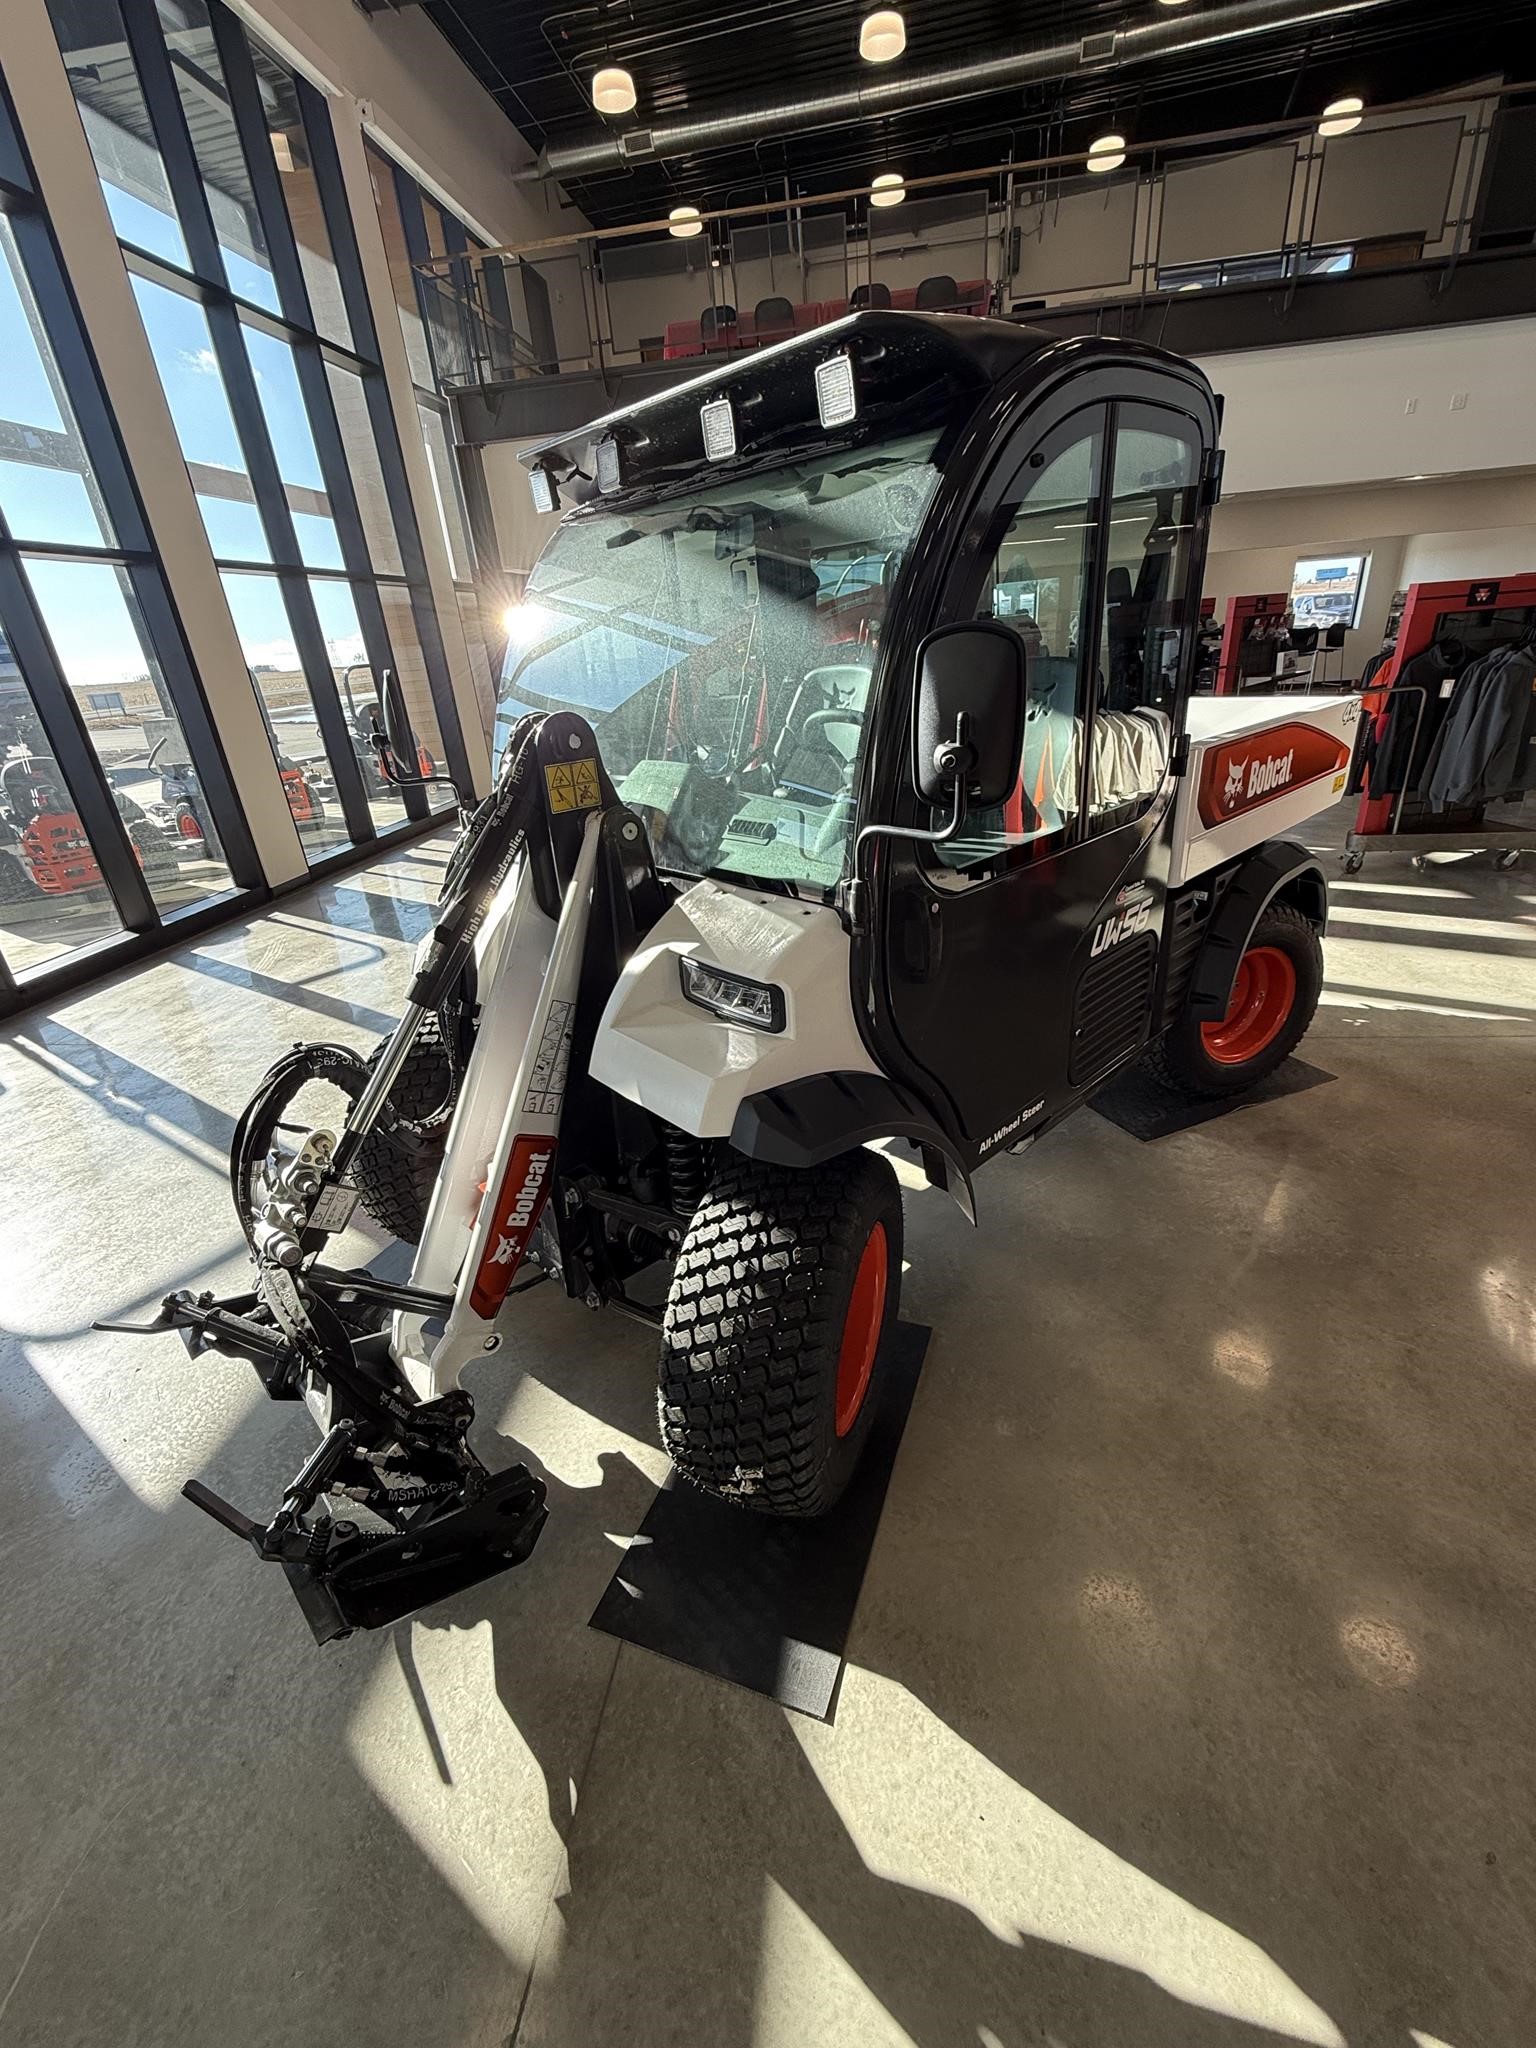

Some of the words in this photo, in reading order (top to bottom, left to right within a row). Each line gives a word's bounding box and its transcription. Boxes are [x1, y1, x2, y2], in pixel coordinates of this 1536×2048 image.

[1247, 749, 1293, 799] Bobcat
[460, 914, 480, 943] High
[475, 889, 496, 920] Flow
[490, 828, 525, 889] Hydraulics
[1091, 897, 1154, 958] UW56
[979, 1115, 1020, 1154] All-Wheel
[1022, 1099, 1045, 1122] Steer
[506, 1151, 551, 1228] Bobcat
